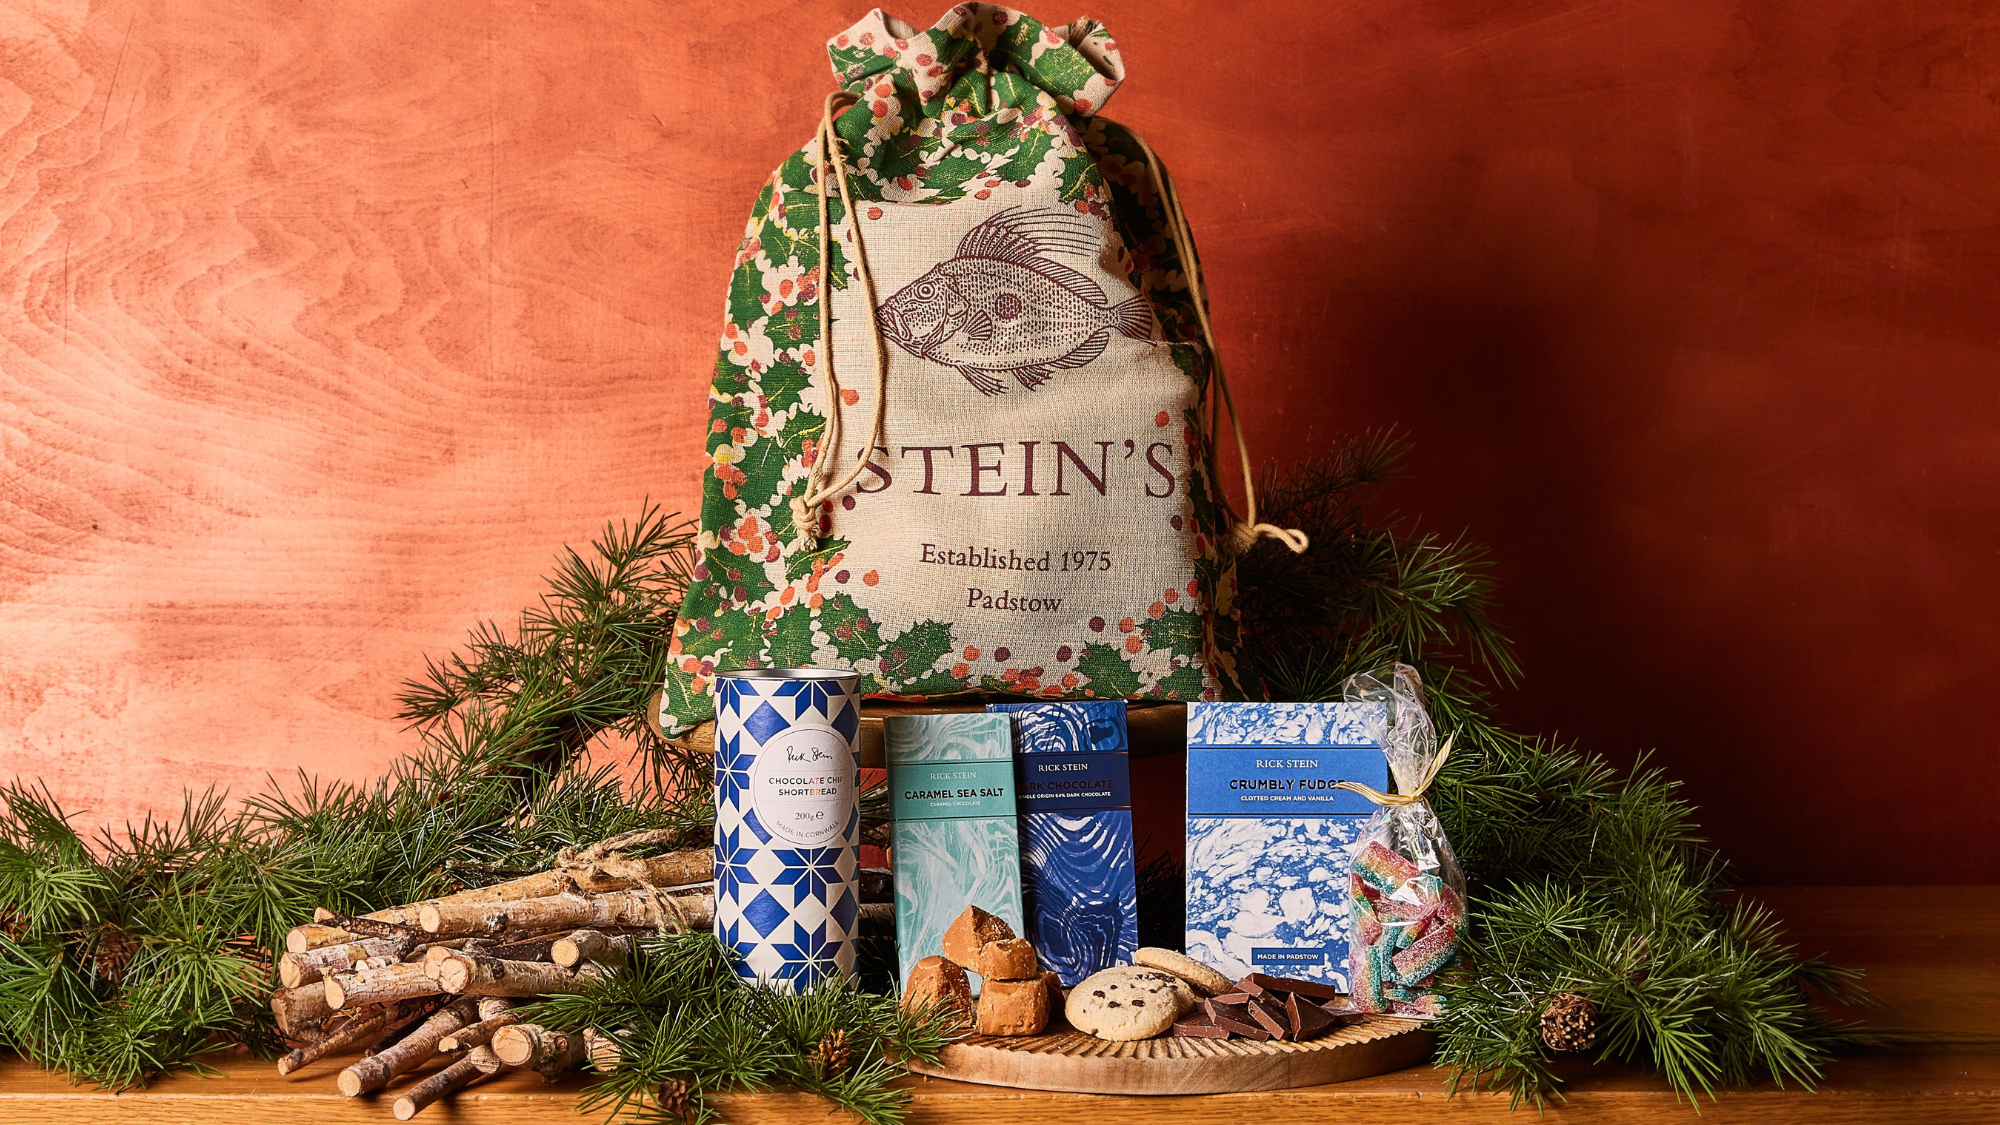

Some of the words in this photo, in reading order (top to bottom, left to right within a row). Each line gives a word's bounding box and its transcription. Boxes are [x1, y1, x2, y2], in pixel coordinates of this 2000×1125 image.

[919, 543, 1050, 572] Established
[1060, 551, 1112, 572] 1975
[966, 587, 1063, 612] Padstow
[1037, 764, 1060, 772] RICK
[1062, 763, 1088, 771] STEIN
[1256, 759, 1284, 768] RICK
[1286, 759, 1318, 768] STEIN
[952, 771, 977, 779] STEIN
[768, 776, 825, 785] CHOCOLATE
[827, 776, 844, 784] CHIP
[1047, 780, 1114, 790] CHOCOLATE
[1229, 779, 1296, 790] CRUMBLY
[778, 787, 837, 796] SHORTBREAD
[904, 790, 954, 800] CARAMEL
[957, 789, 977, 798] SEA
[980, 787, 1004, 797] SALT
[795, 812, 815, 821] 200g
[776, 820, 795, 835] MADE
[805, 821, 840, 838] CORNWALL
